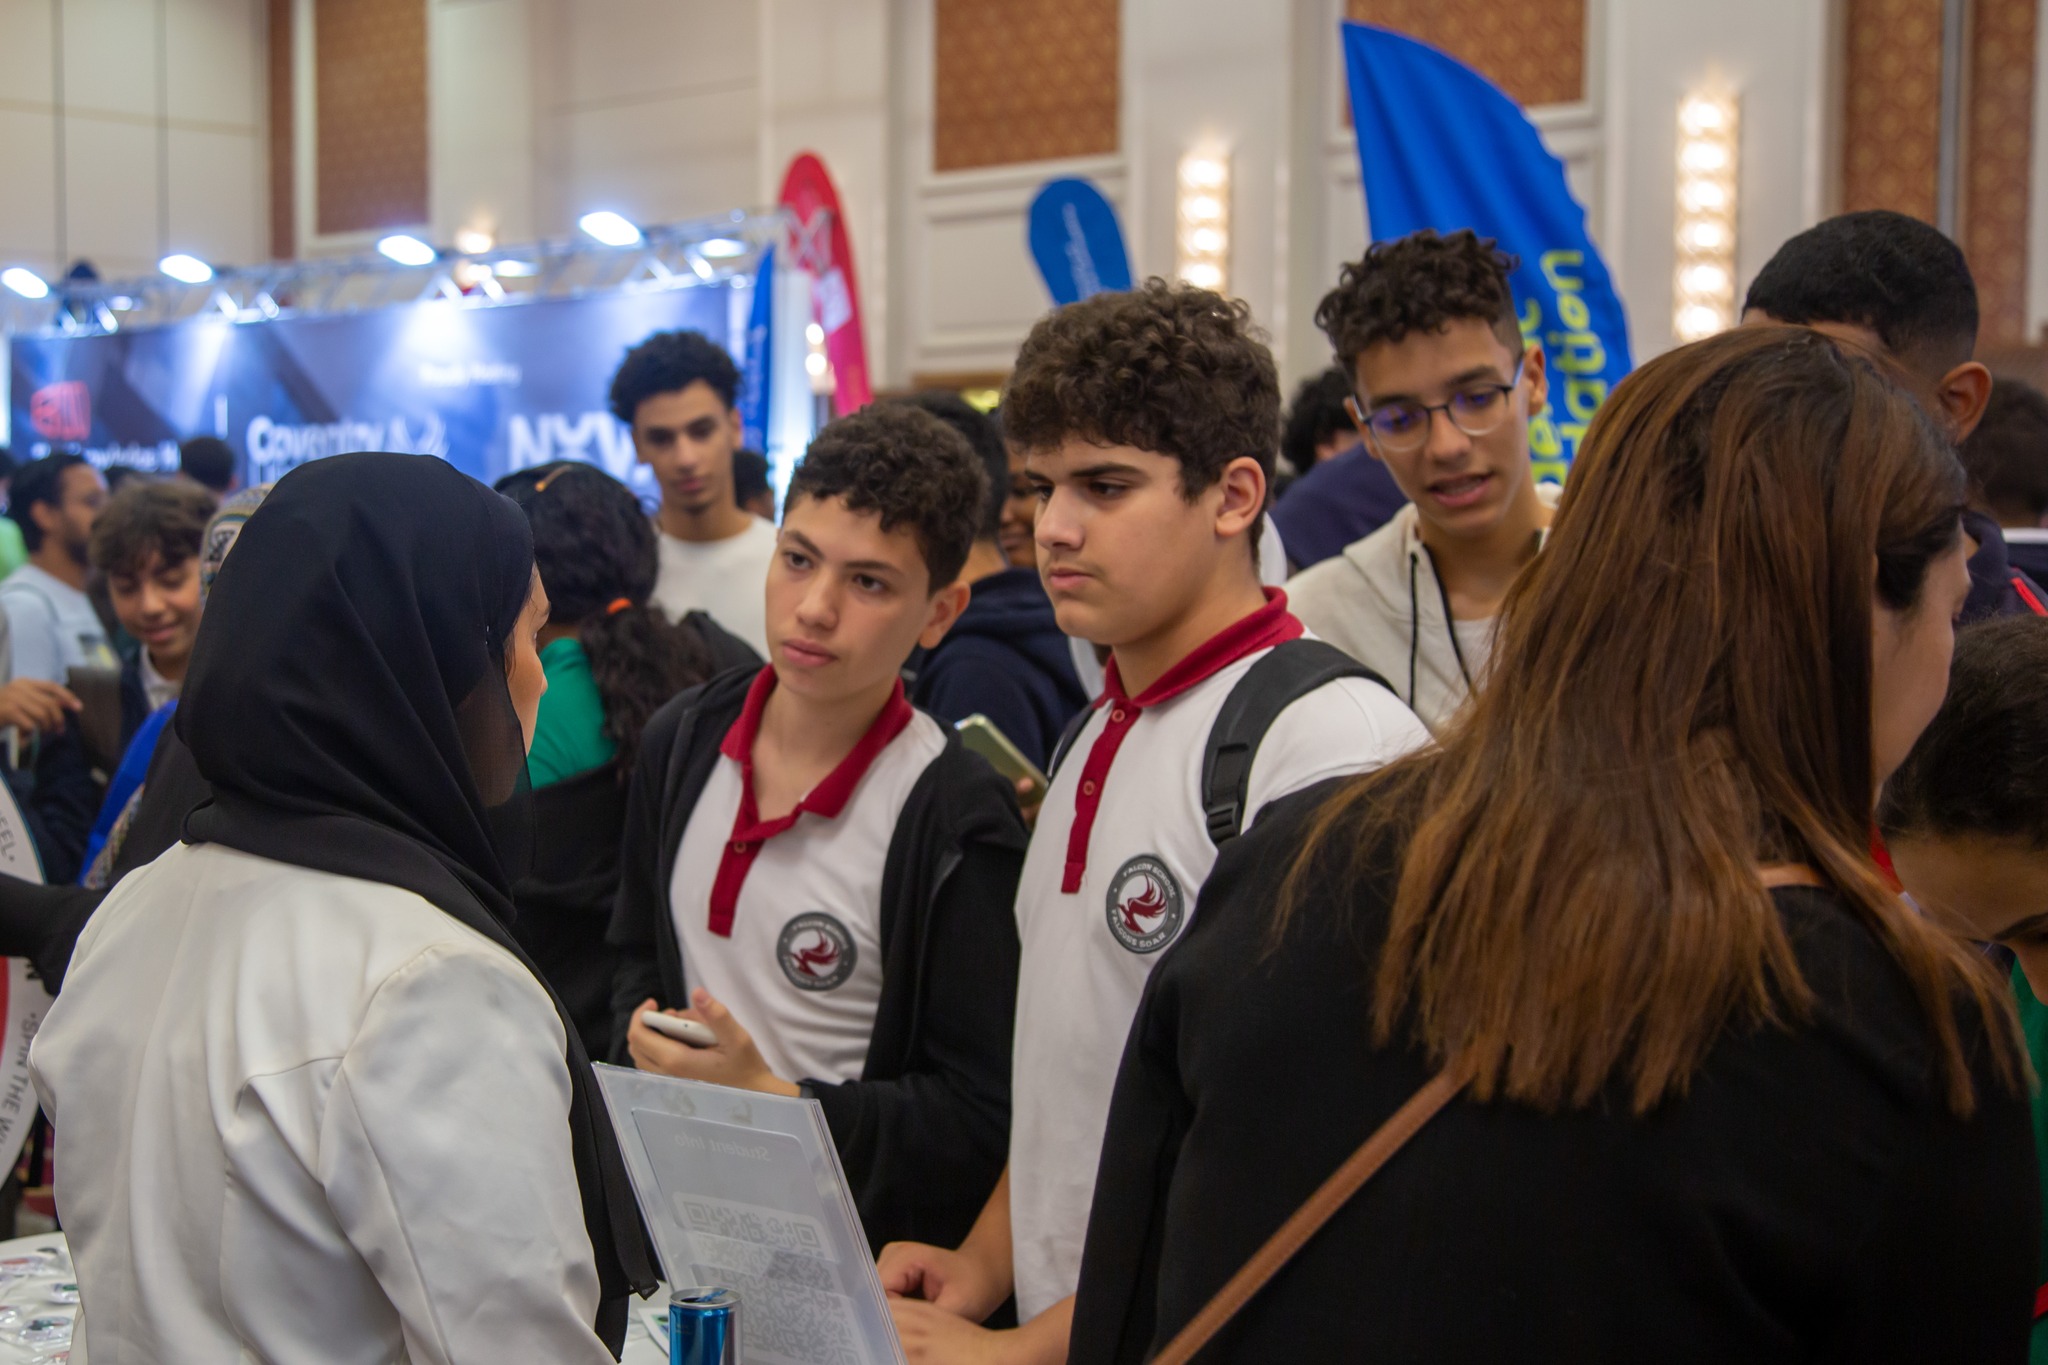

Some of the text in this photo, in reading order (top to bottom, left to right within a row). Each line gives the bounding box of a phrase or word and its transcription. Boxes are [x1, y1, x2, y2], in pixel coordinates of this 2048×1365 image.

[1123, 863, 1176, 898] FALCON SCHOOL
[3, 1074, 29, 1115] THE
